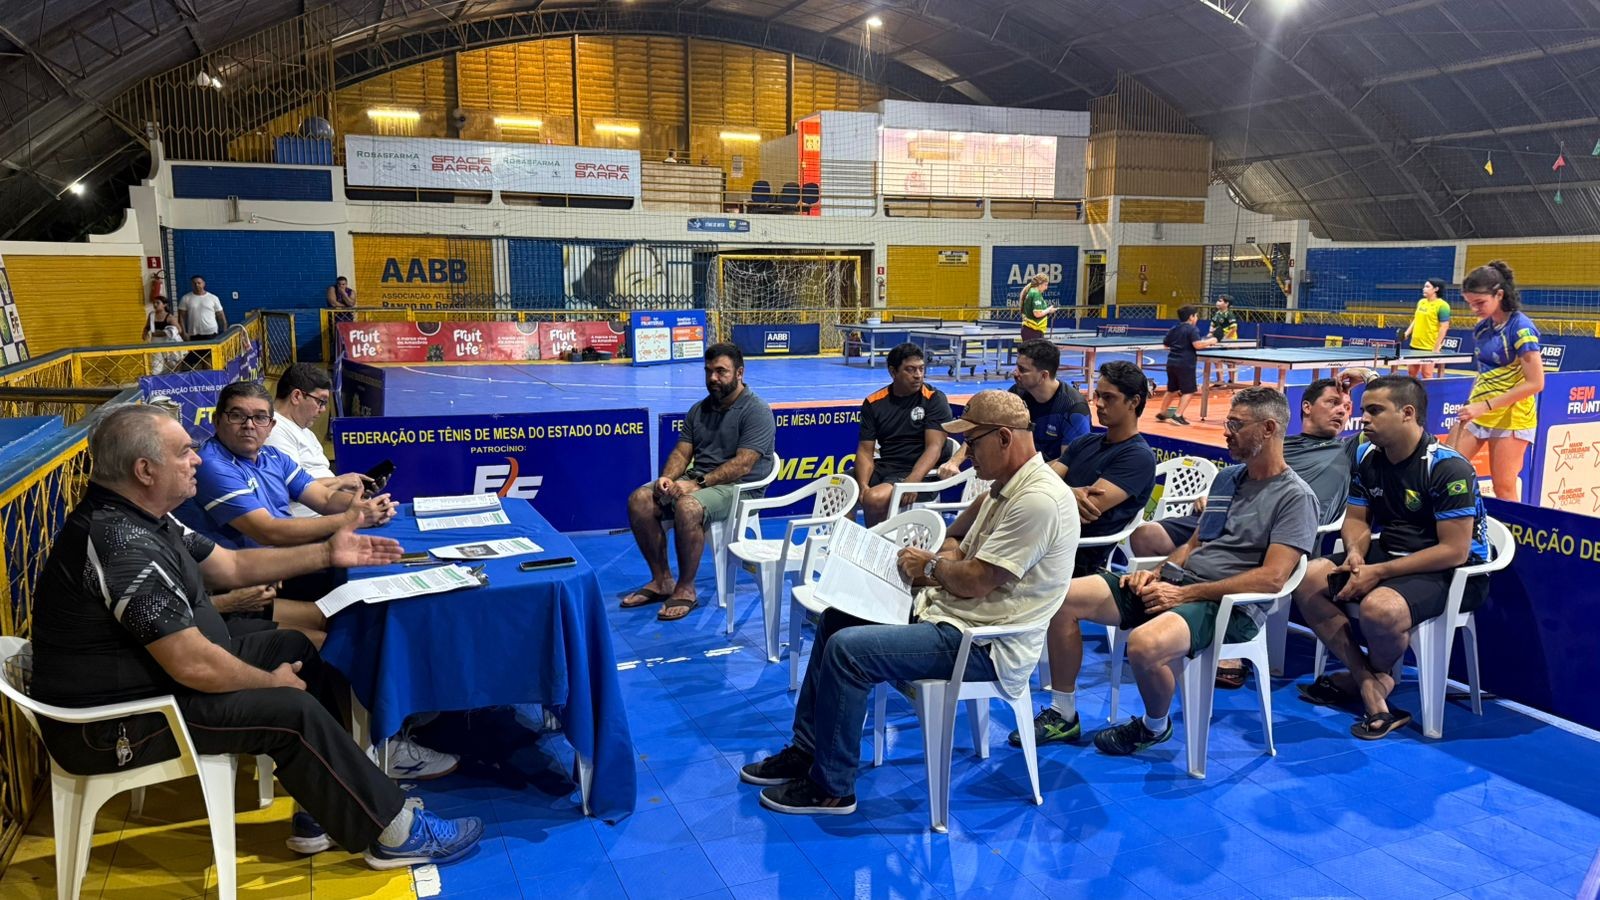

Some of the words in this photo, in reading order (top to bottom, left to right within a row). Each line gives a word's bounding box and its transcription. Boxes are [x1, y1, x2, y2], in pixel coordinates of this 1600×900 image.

[431, 155, 492, 163] GRACIE
[431, 163, 493, 174] BARRA
[575, 162, 630, 172] GRACIE
[575, 170, 630, 181] BARRA
[381, 257, 468, 284] AABB
[1008, 263, 1063, 285] AABB
[349, 330, 381, 343] Fruit
[453, 329, 483, 342] Fruit
[549, 329, 577, 341] Fruit
[767, 333, 788, 341] AABB
[352, 343, 377, 358] Life
[456, 343, 480, 356] Life
[1540, 346, 1562, 357] ABB
[151, 386, 188, 396] FEDERAÇÃO
[1569, 386, 1595, 400] SEM
[1567, 400, 1600, 415] FRONT
[777, 414, 788, 427] DE
[790, 412, 816, 426] MESA
[818, 412, 832, 424] DO
[835, 410, 861, 424] ESTAD
[341, 428, 416, 446] FEDERAÇÃO
[419, 430, 435, 442] DE
[437, 427, 472, 442] TÊNIS
[474, 428, 490, 441] DE
[493, 426, 525, 440] MESA
[528, 426, 545, 438] DO
[547, 424, 592, 437] ESTADO
[595, 423, 612, 436] DO
[614, 422, 644, 435] ACRE
[470, 444, 527, 454] PATROCÍNIO:
[778, 453, 857, 481] MEAC
[1503, 522, 1575, 556] RAÇÃO
[1580, 538, 1600, 562] DE
